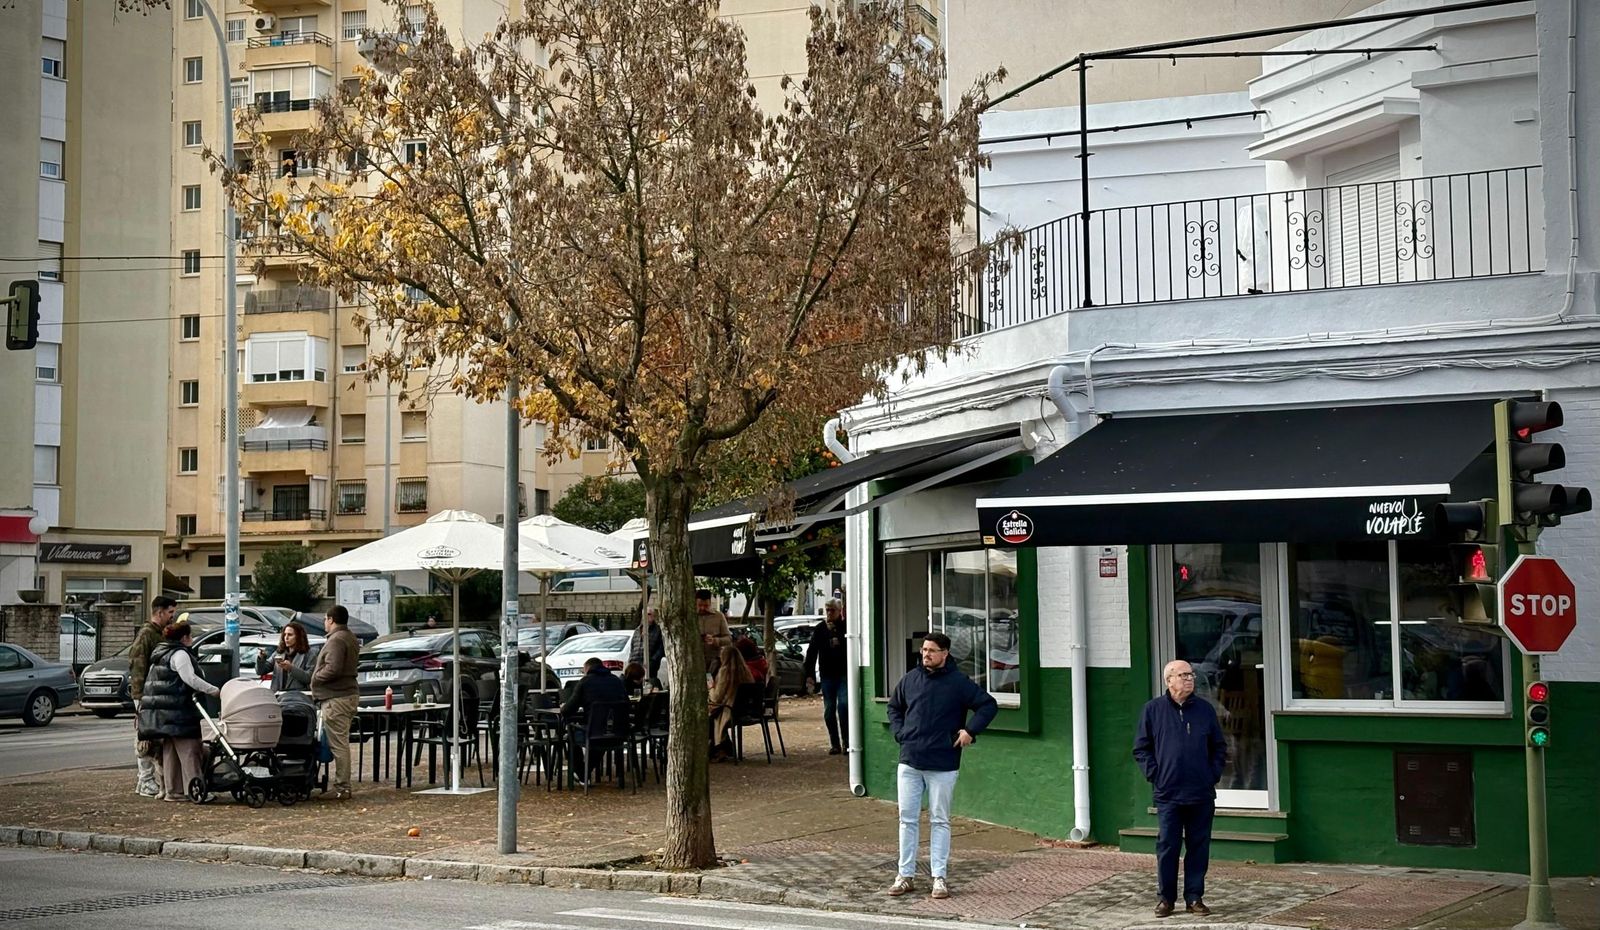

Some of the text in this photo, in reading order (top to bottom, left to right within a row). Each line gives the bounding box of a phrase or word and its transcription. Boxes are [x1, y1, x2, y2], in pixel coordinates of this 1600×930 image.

[1369, 501, 1402, 514] NUEVO
[1002, 520, 1028, 528] Estrella
[1003, 527, 1027, 535] Galicia
[47, 545, 102, 560] Villanueva
[1510, 594, 1571, 616] STOP
